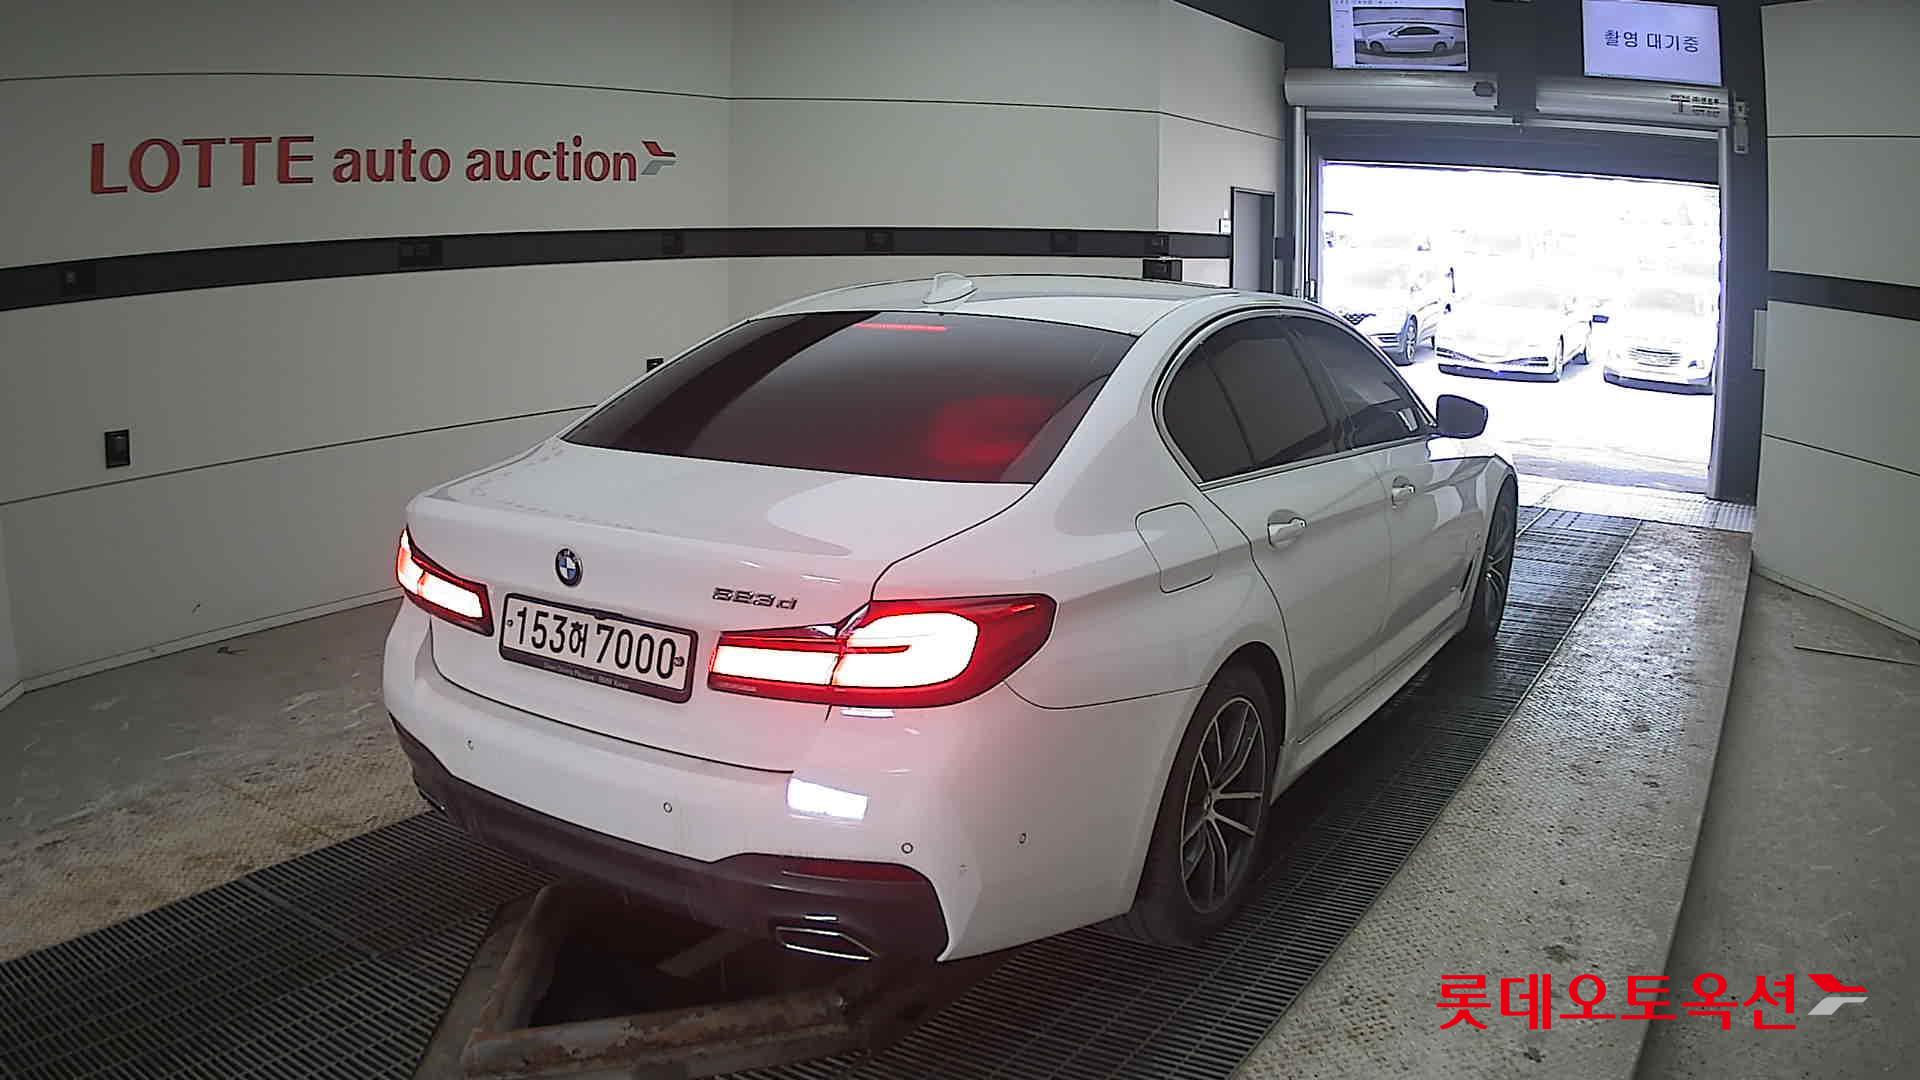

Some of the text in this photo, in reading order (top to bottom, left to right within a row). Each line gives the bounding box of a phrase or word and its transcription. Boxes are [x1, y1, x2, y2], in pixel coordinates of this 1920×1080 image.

[1603, 29, 1700, 53] 촬영 대기중
[91, 135, 637, 194] LOTTE auto auction
[595, 623, 676, 679] 7000
